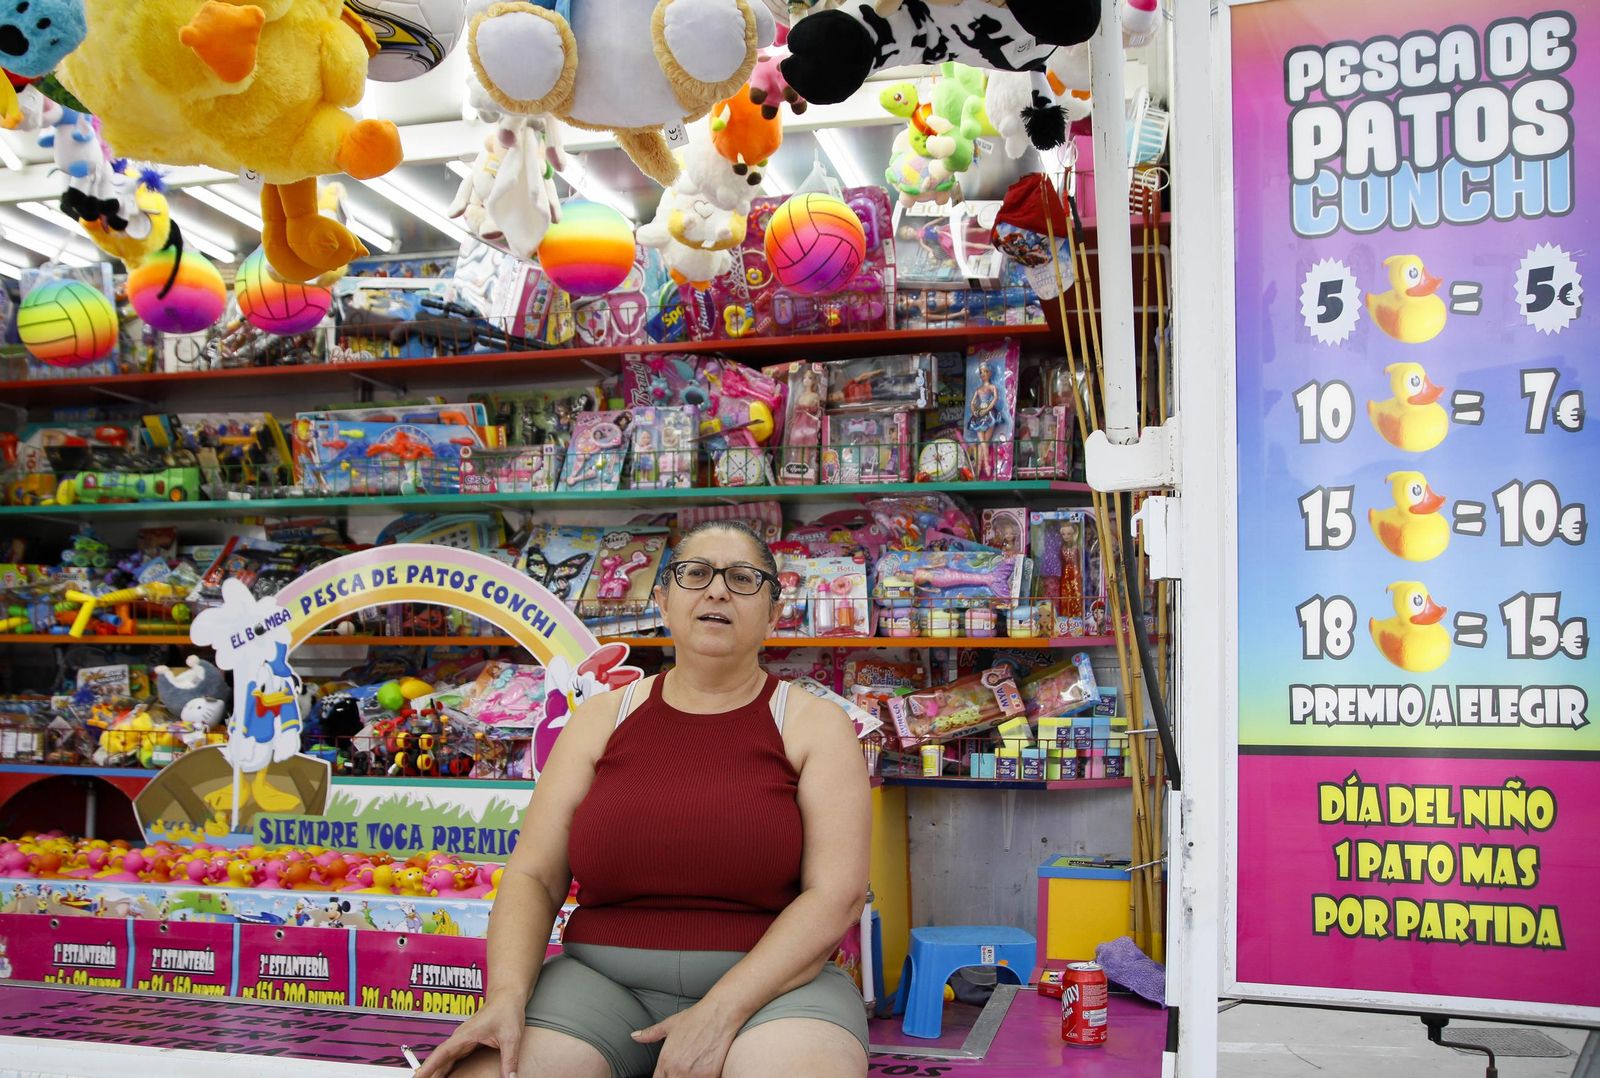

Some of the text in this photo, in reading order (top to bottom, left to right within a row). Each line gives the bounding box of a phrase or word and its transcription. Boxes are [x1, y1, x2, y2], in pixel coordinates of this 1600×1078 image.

[1286, 12, 1575, 103] PESCA DE
[1290, 77, 1572, 182] PATOS
[1291, 152, 1573, 237] CONCHI
[1316, 279, 1344, 324] 5
[1526, 265, 1575, 313] 5€
[1293, 379, 1355, 444] 10
[1520, 368, 1584, 434] 7€
[1298, 485, 1355, 550] 15
[1492, 479, 1588, 547] 10€
[299, 565, 557, 639] PESCA DE PATOS CONCHI
[1296, 594, 1356, 659] 18
[1499, 591, 1590, 659] 15€
[230, 633, 246, 649] EL
[1289, 684, 1590, 729] PREMIO A ELEGIR
[1317, 770, 1557, 834] DÍA DEL NIÑO
[258, 817, 359, 849] SIEMPRE
[366, 822, 424, 850] TOCA
[1332, 838, 1540, 890] 1 PATO MAS
[1312, 894, 1566, 950] POR PARTIDA
[62, 941, 117, 966] ESTANTERÍA
[161, 946, 215, 971] ESTANTERÍA
[269, 952, 329, 977] ESTANTERÍA
[422, 964, 483, 990] ESTANTERÍA
